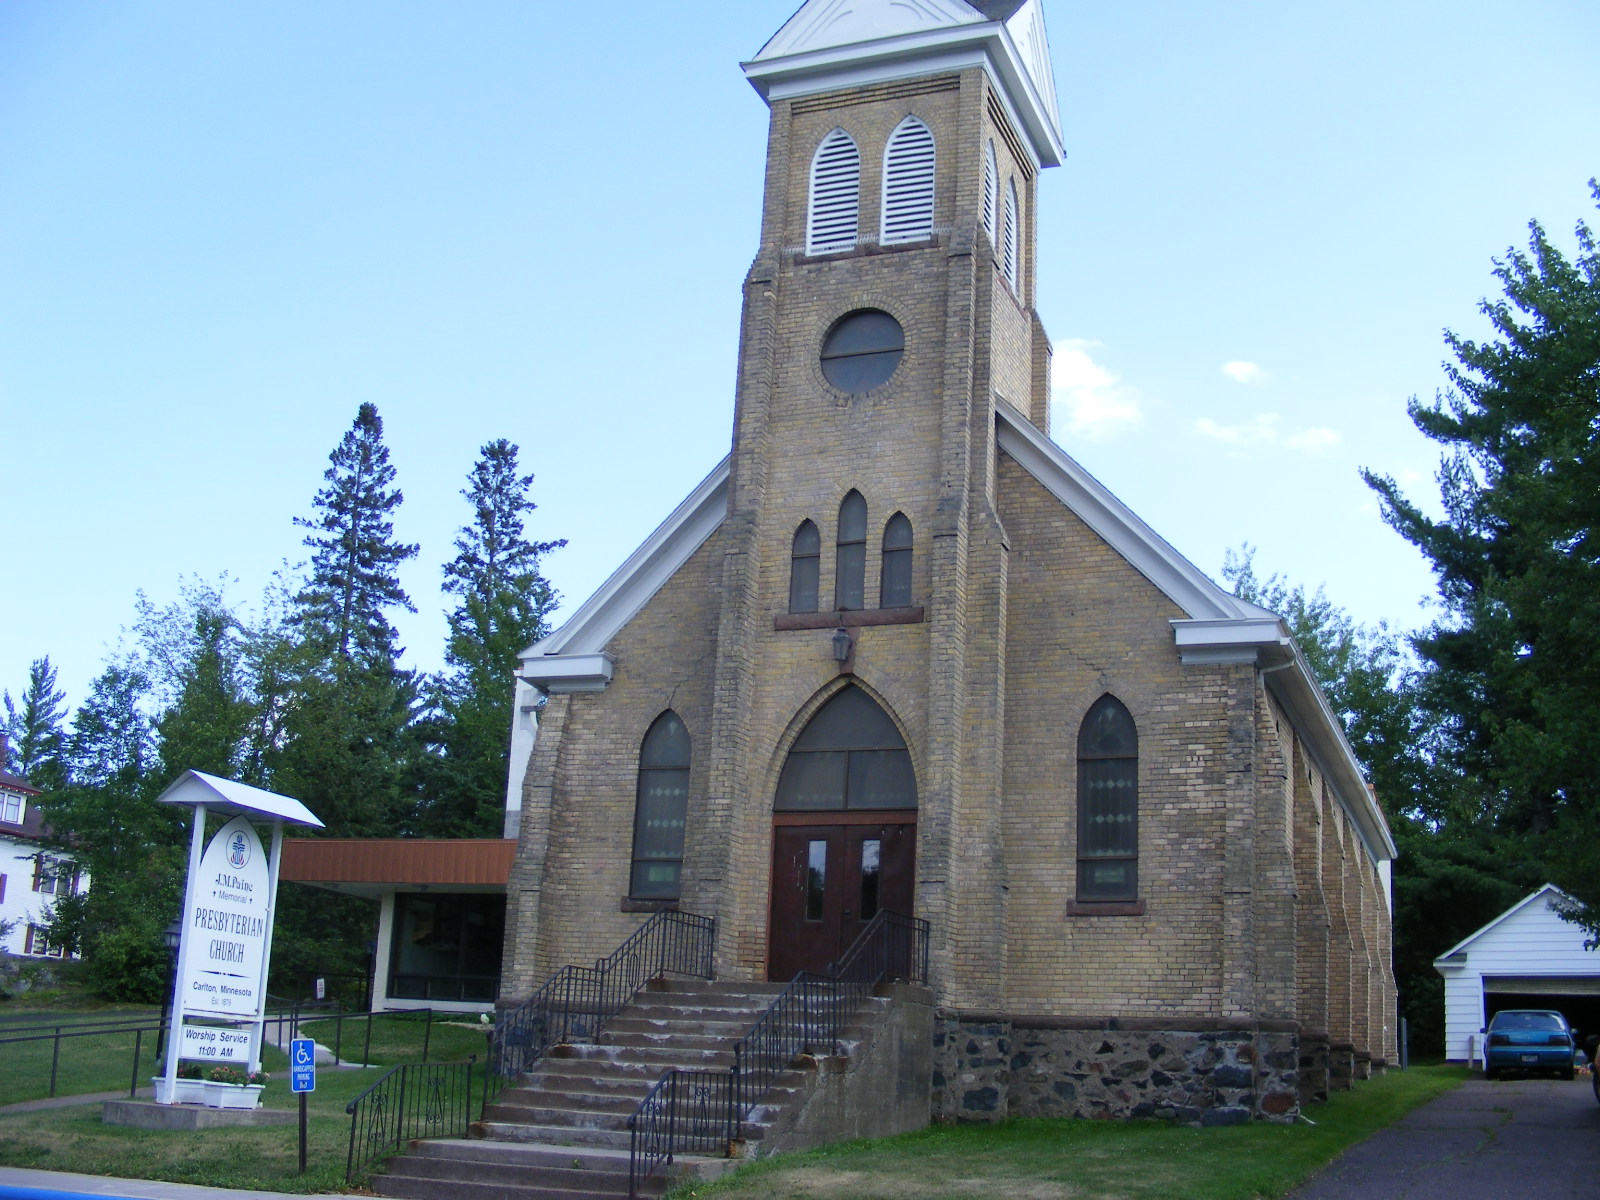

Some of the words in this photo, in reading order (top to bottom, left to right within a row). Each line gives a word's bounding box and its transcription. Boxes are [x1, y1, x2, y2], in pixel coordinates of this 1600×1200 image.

[218, 890, 247, 904] Memorial
[194, 908, 264, 938] PRESBYTERIAN
[210, 939, 244, 963] CHURCH
[220, 985, 252, 996] Minnesota
[186, 1028, 216, 1043] Worship
[220, 1032, 248, 1044] Service
[198, 1046, 216, 1056] 11:00
[220, 1048, 233, 1057] AM
